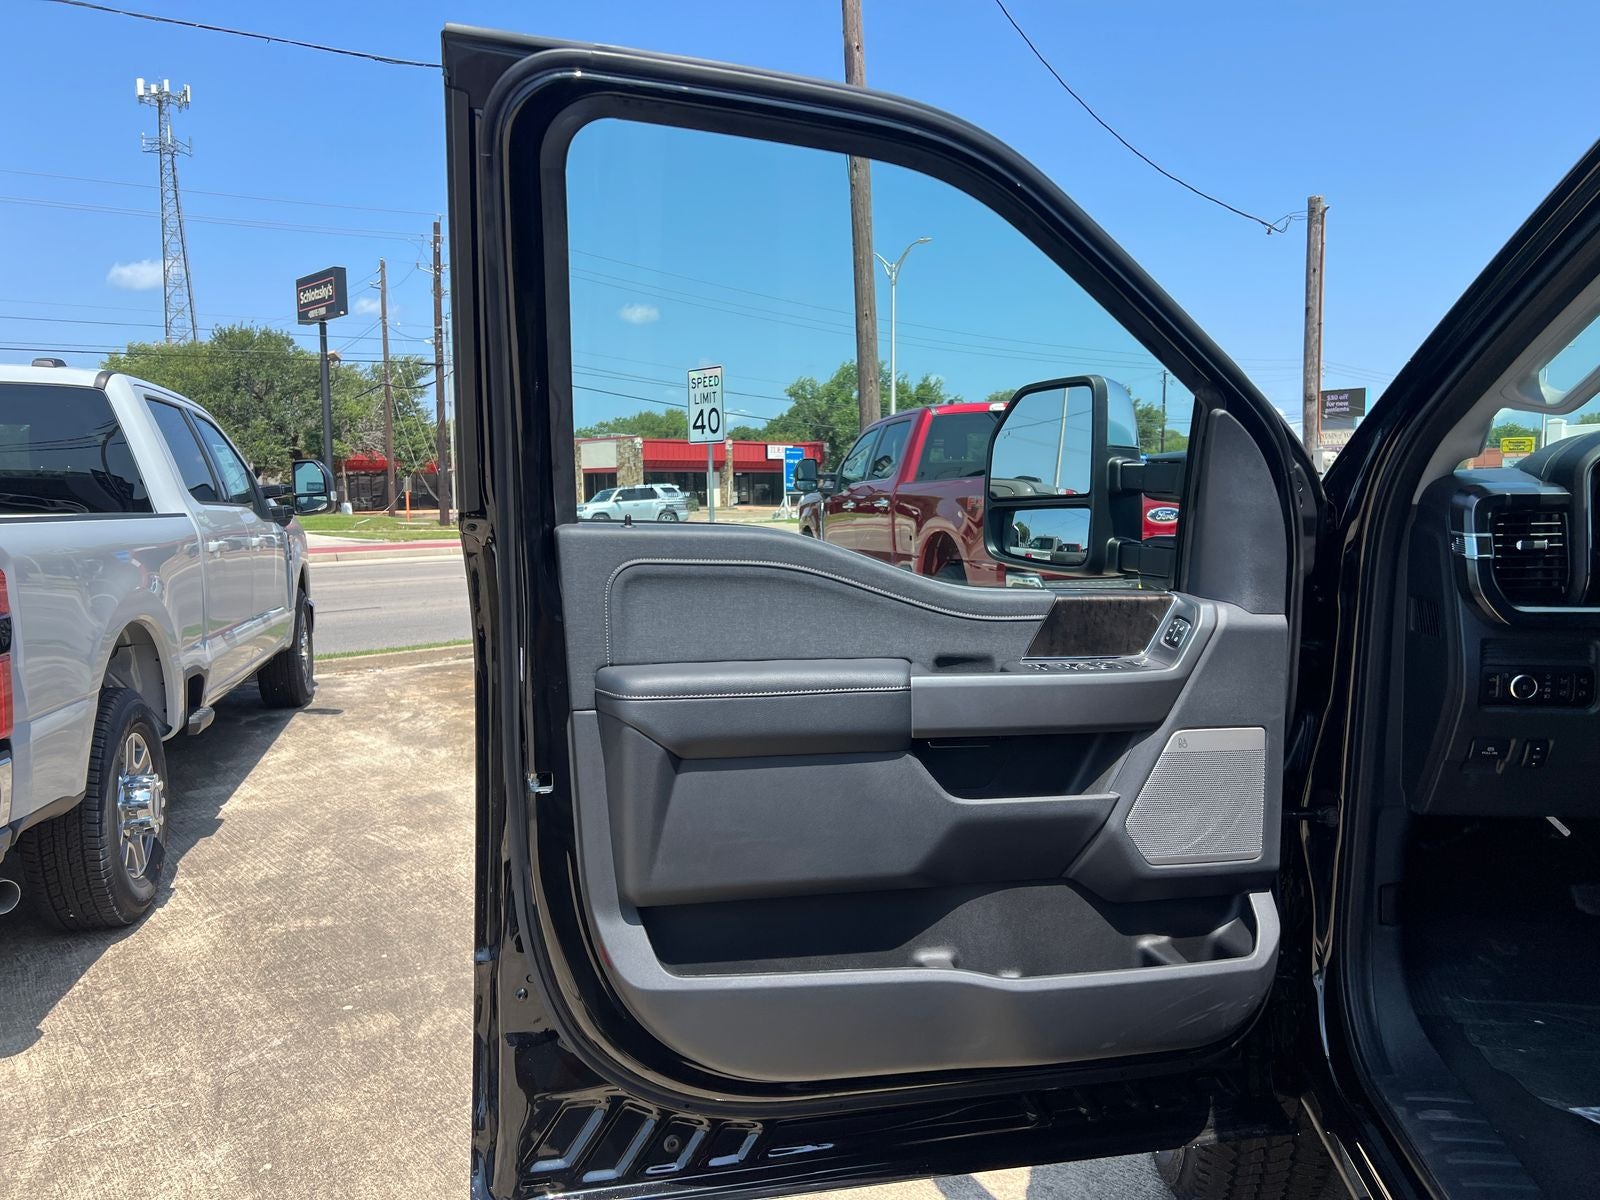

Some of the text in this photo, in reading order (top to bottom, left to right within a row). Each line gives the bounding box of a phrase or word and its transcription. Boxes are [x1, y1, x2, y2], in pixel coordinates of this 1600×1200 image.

[300, 283, 333, 305] Schlotzsky's
[691, 375, 720, 389] SPEED
[694, 392, 717, 405] LIMIT
[692, 407, 720, 435] 40
